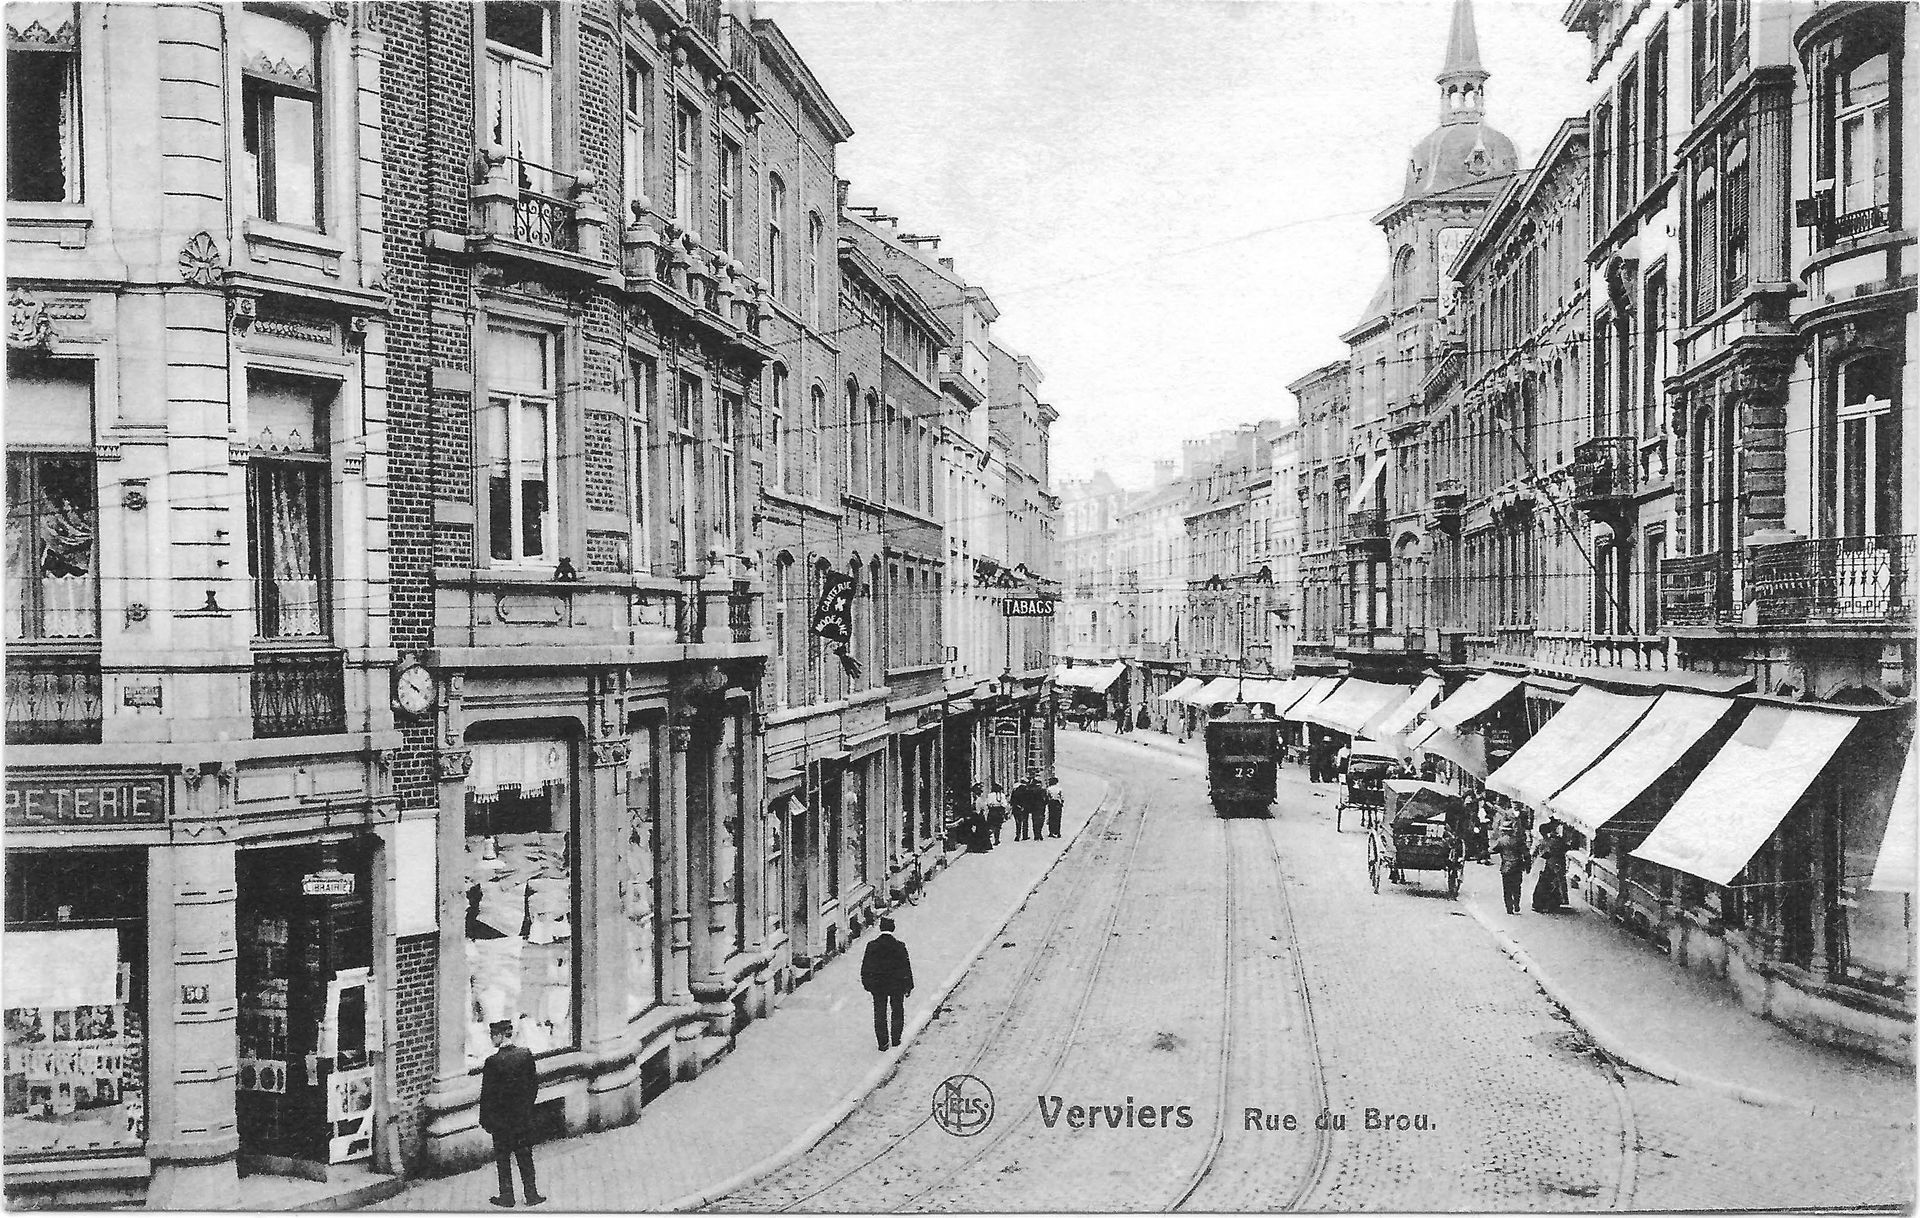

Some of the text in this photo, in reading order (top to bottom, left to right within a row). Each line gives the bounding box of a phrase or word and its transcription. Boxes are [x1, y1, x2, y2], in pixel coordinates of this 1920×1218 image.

[815, 614, 848, 636] MODERNE
[5, 786, 151, 819] PETERIE
[304, 882, 349, 893] LIBRAIRIE
[186, 987, 204, 1000] 50
